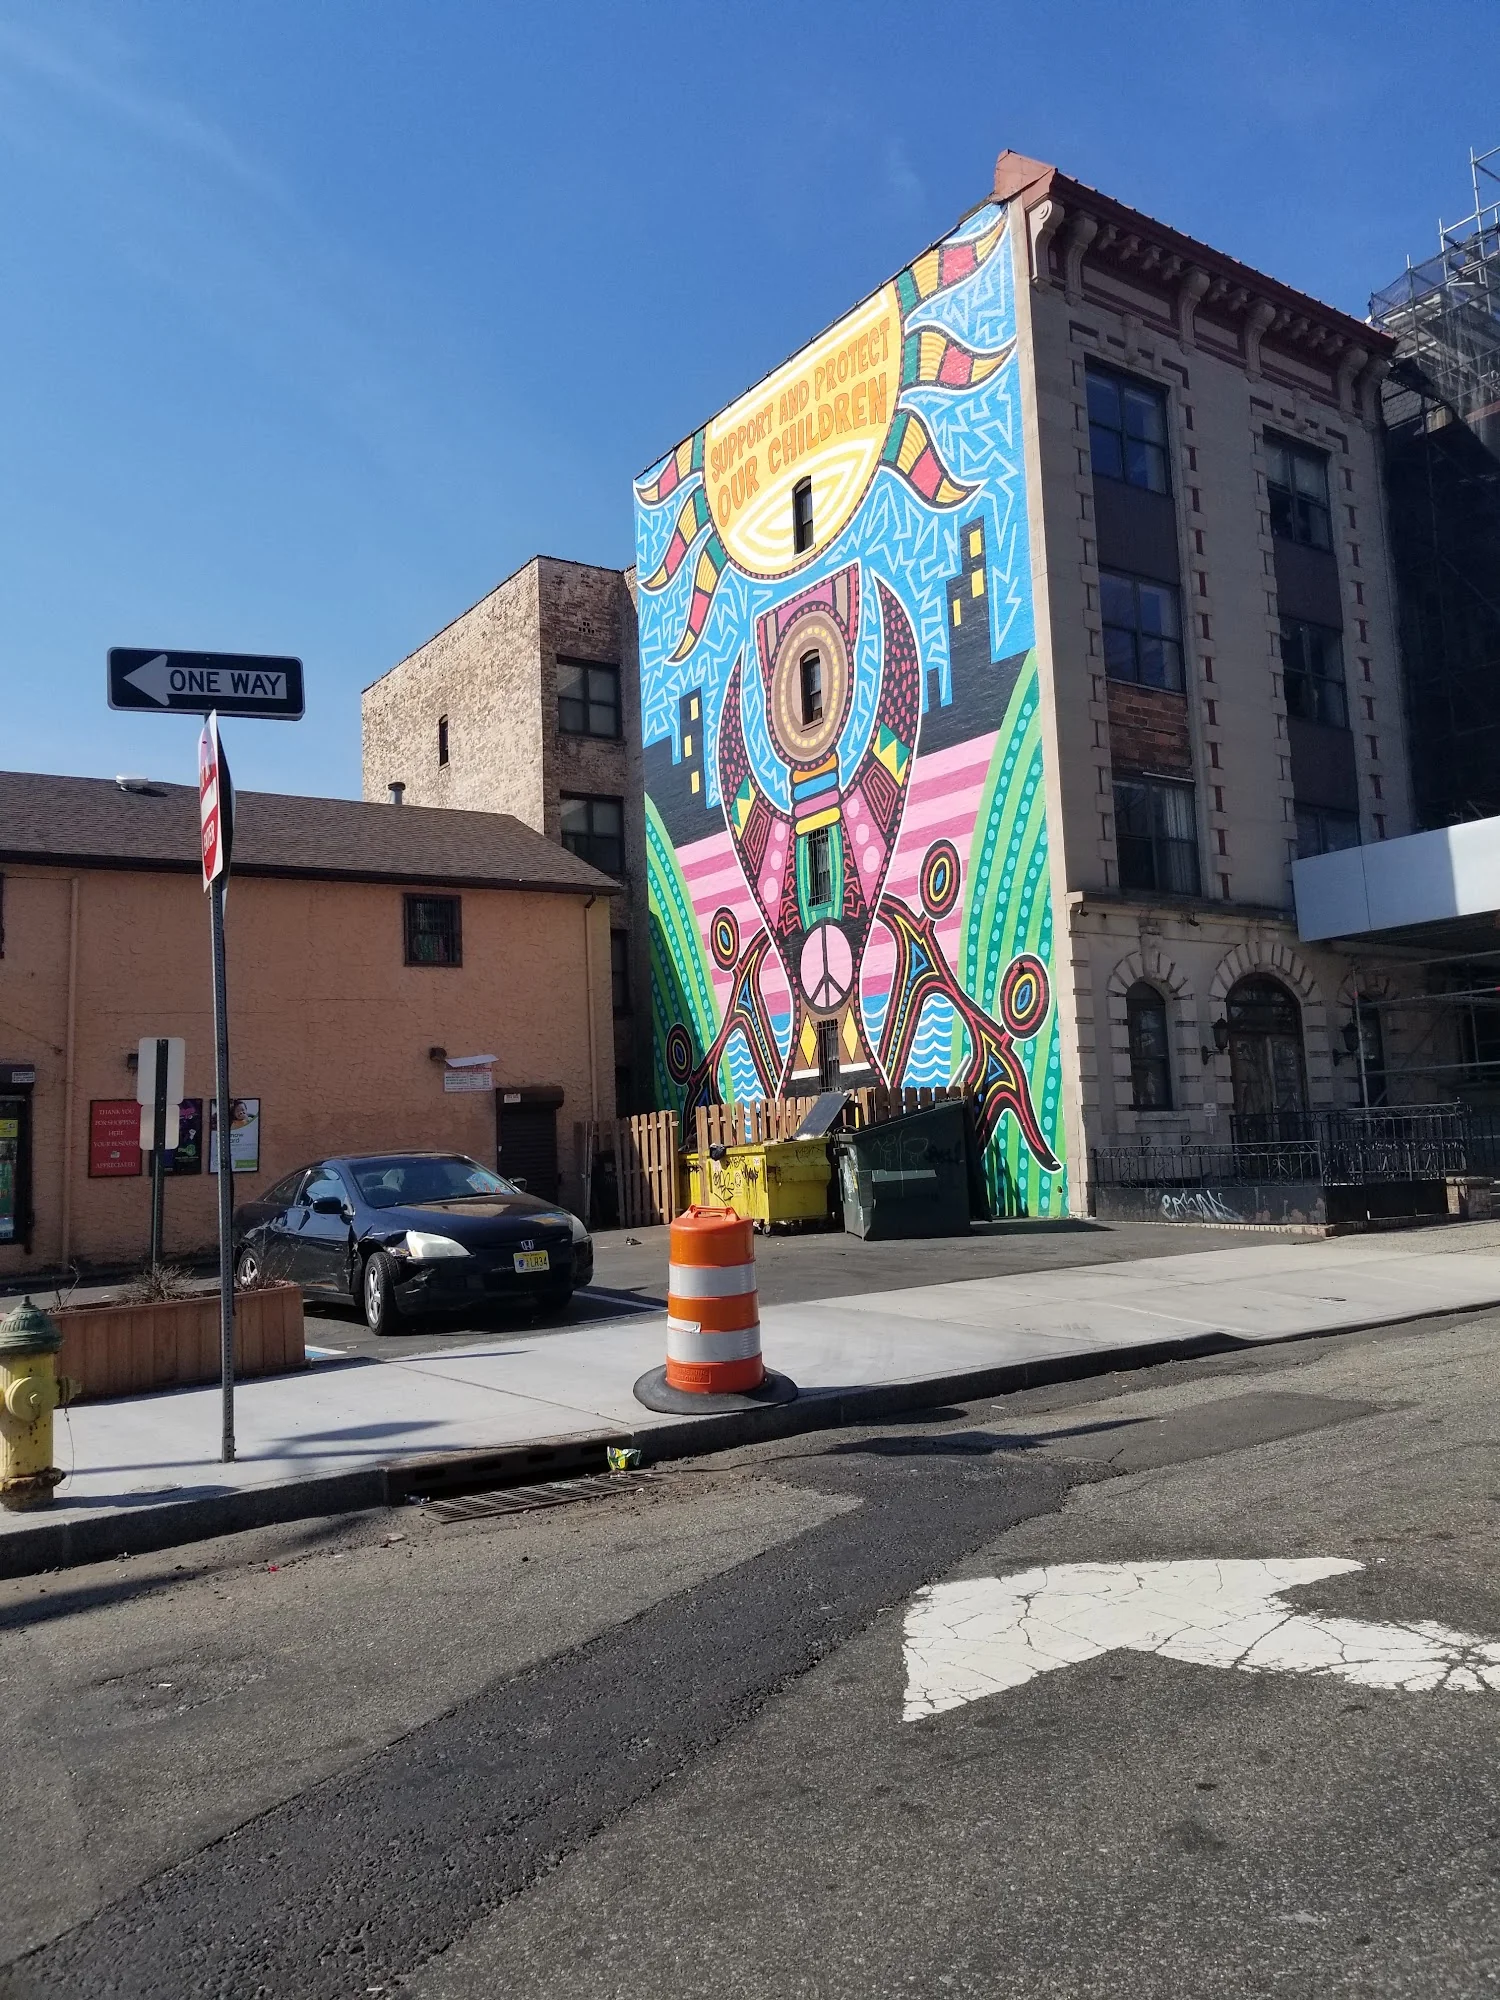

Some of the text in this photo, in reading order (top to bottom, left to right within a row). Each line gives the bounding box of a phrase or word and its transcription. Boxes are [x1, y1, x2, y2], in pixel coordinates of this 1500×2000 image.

[710, 316, 890, 483] SUPPORT AND PROTECT
[717, 371, 887, 528] OUR CHILDREN
[169, 669, 282, 696] ONE WAY
